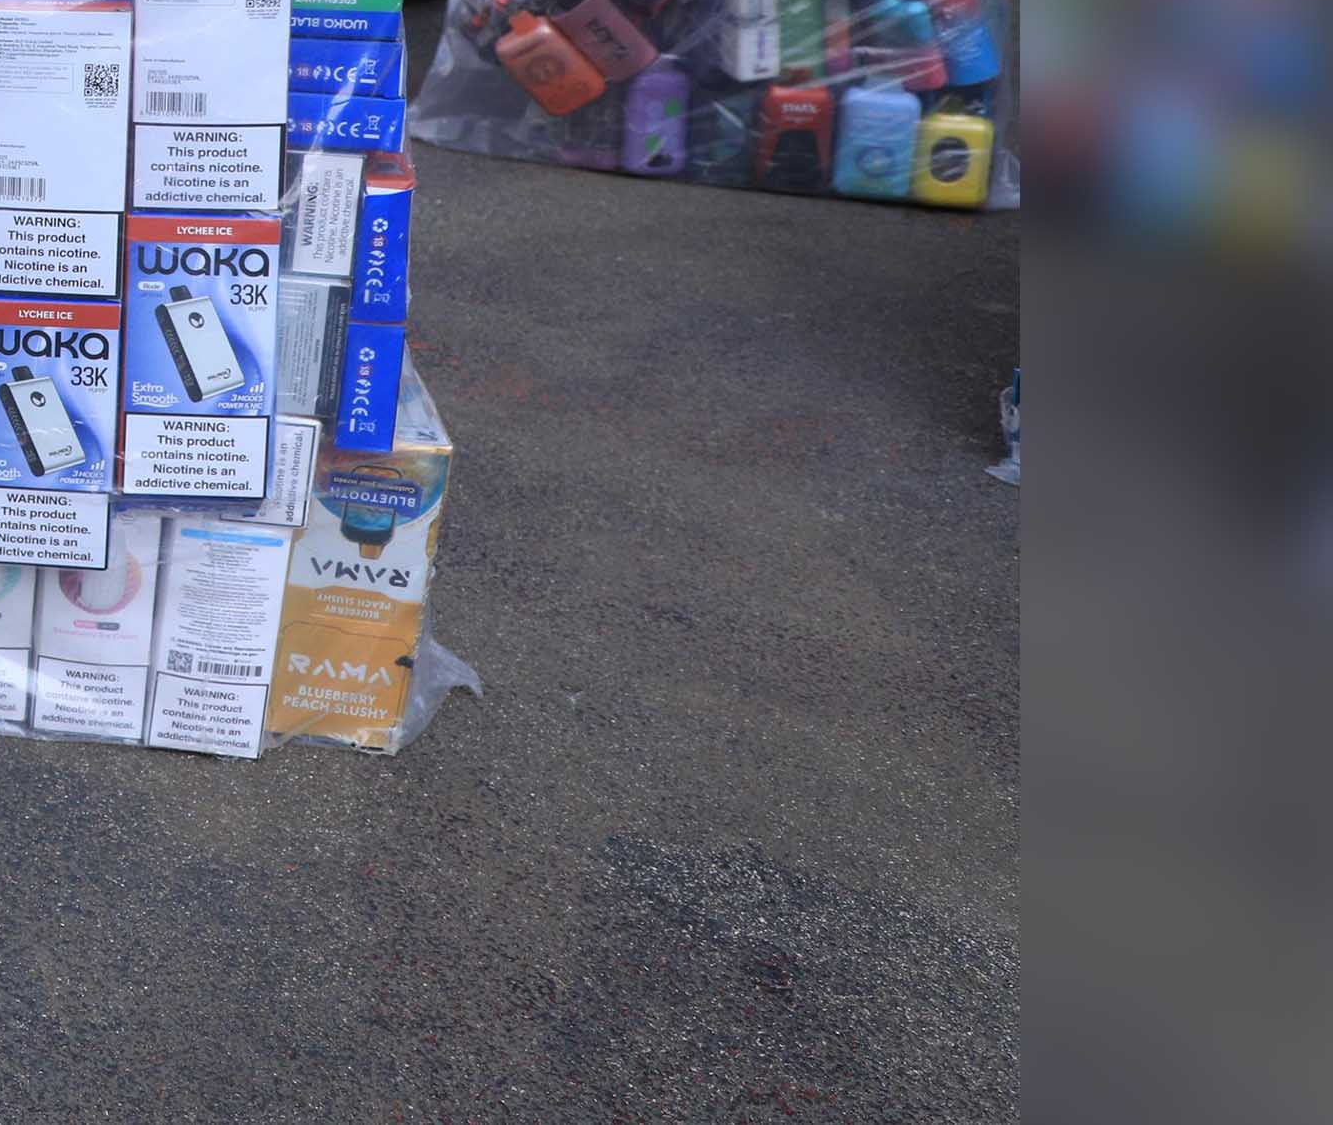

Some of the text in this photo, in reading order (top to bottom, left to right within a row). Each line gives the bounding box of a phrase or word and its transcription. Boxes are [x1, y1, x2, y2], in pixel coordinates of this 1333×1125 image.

[301, 181, 319, 248] WARNING:
[176, 225, 233, 237] LYCHEE ICE
[230, 284, 268, 305] 33K
[18, 309, 74, 321] LYCHEE ICE
[70, 366, 109, 388] 33K
[133, 381, 164, 393] Extra
[133, 392, 178, 405] Smooth
[162, 420, 230, 433] WARNING:
[156, 434, 235, 449] This product
[141, 449, 250, 463] contains nicotine.
[152, 463, 237, 477] Nicotine is an
[134, 477, 253, 491] addictive chemical.
[311, 557, 411, 588] RAMA
[287, 652, 392, 686] RAMA
[298, 684, 377, 706] BLUEBERRY
[283, 695, 389, 720] PEACH SLUSHY
